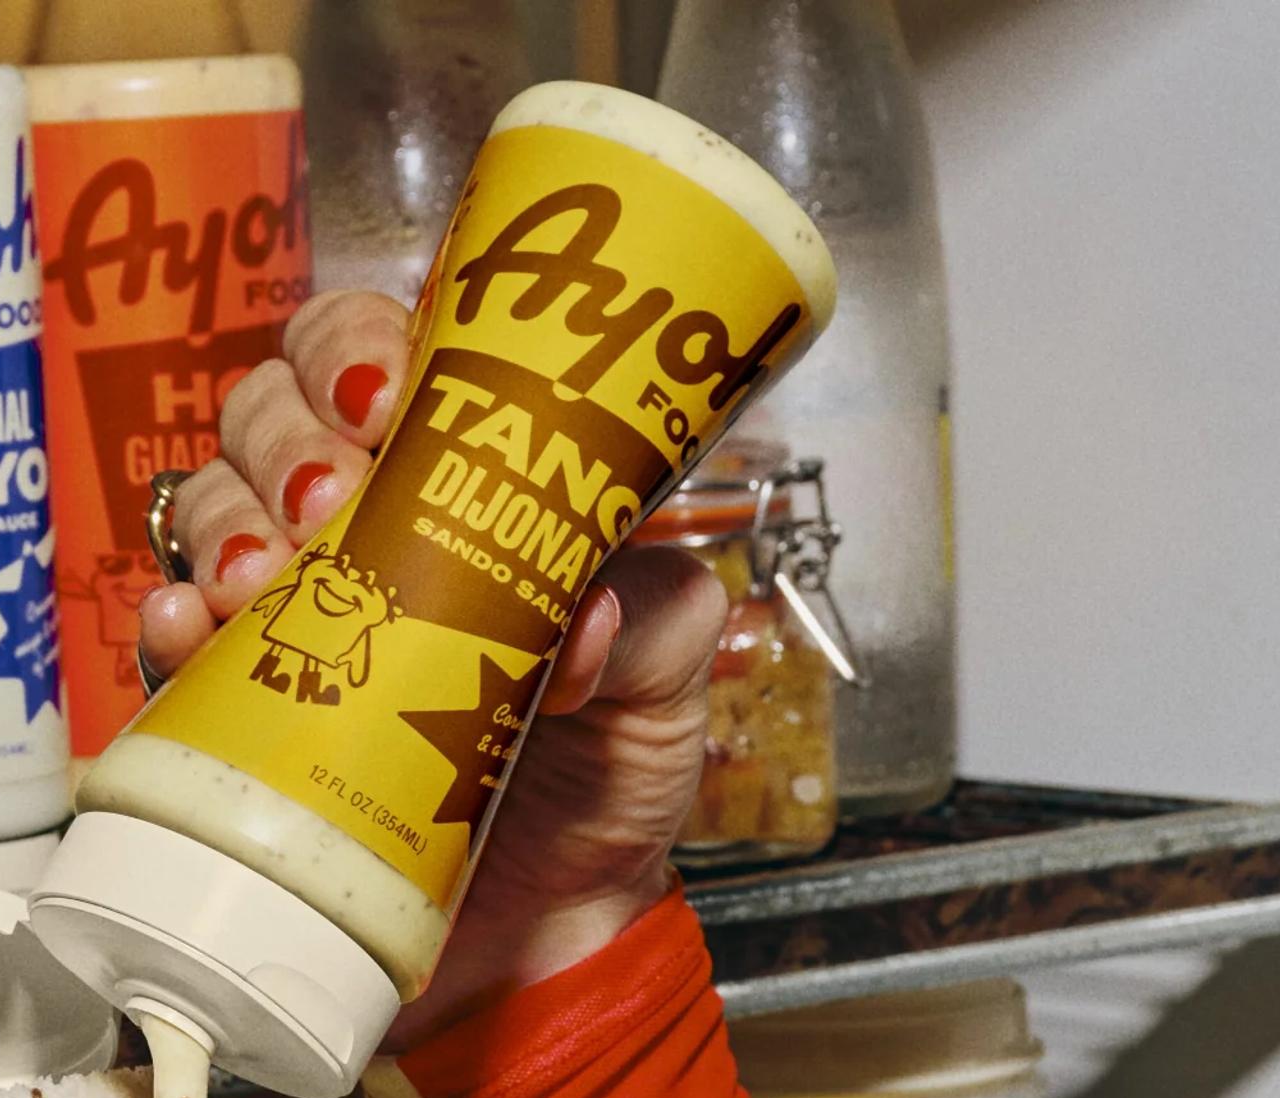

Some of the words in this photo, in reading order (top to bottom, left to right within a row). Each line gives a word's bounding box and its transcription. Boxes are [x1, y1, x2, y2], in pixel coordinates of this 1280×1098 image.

[245, 276, 313, 309] FOO
[412, 516, 513, 584] SANDO
[476, 733, 493, 753] &
[308, 764, 328, 785] 12
[327, 776, 346, 800] FL
[350, 791, 374, 814] OZ
[372, 804, 427, 856] (354ML)
